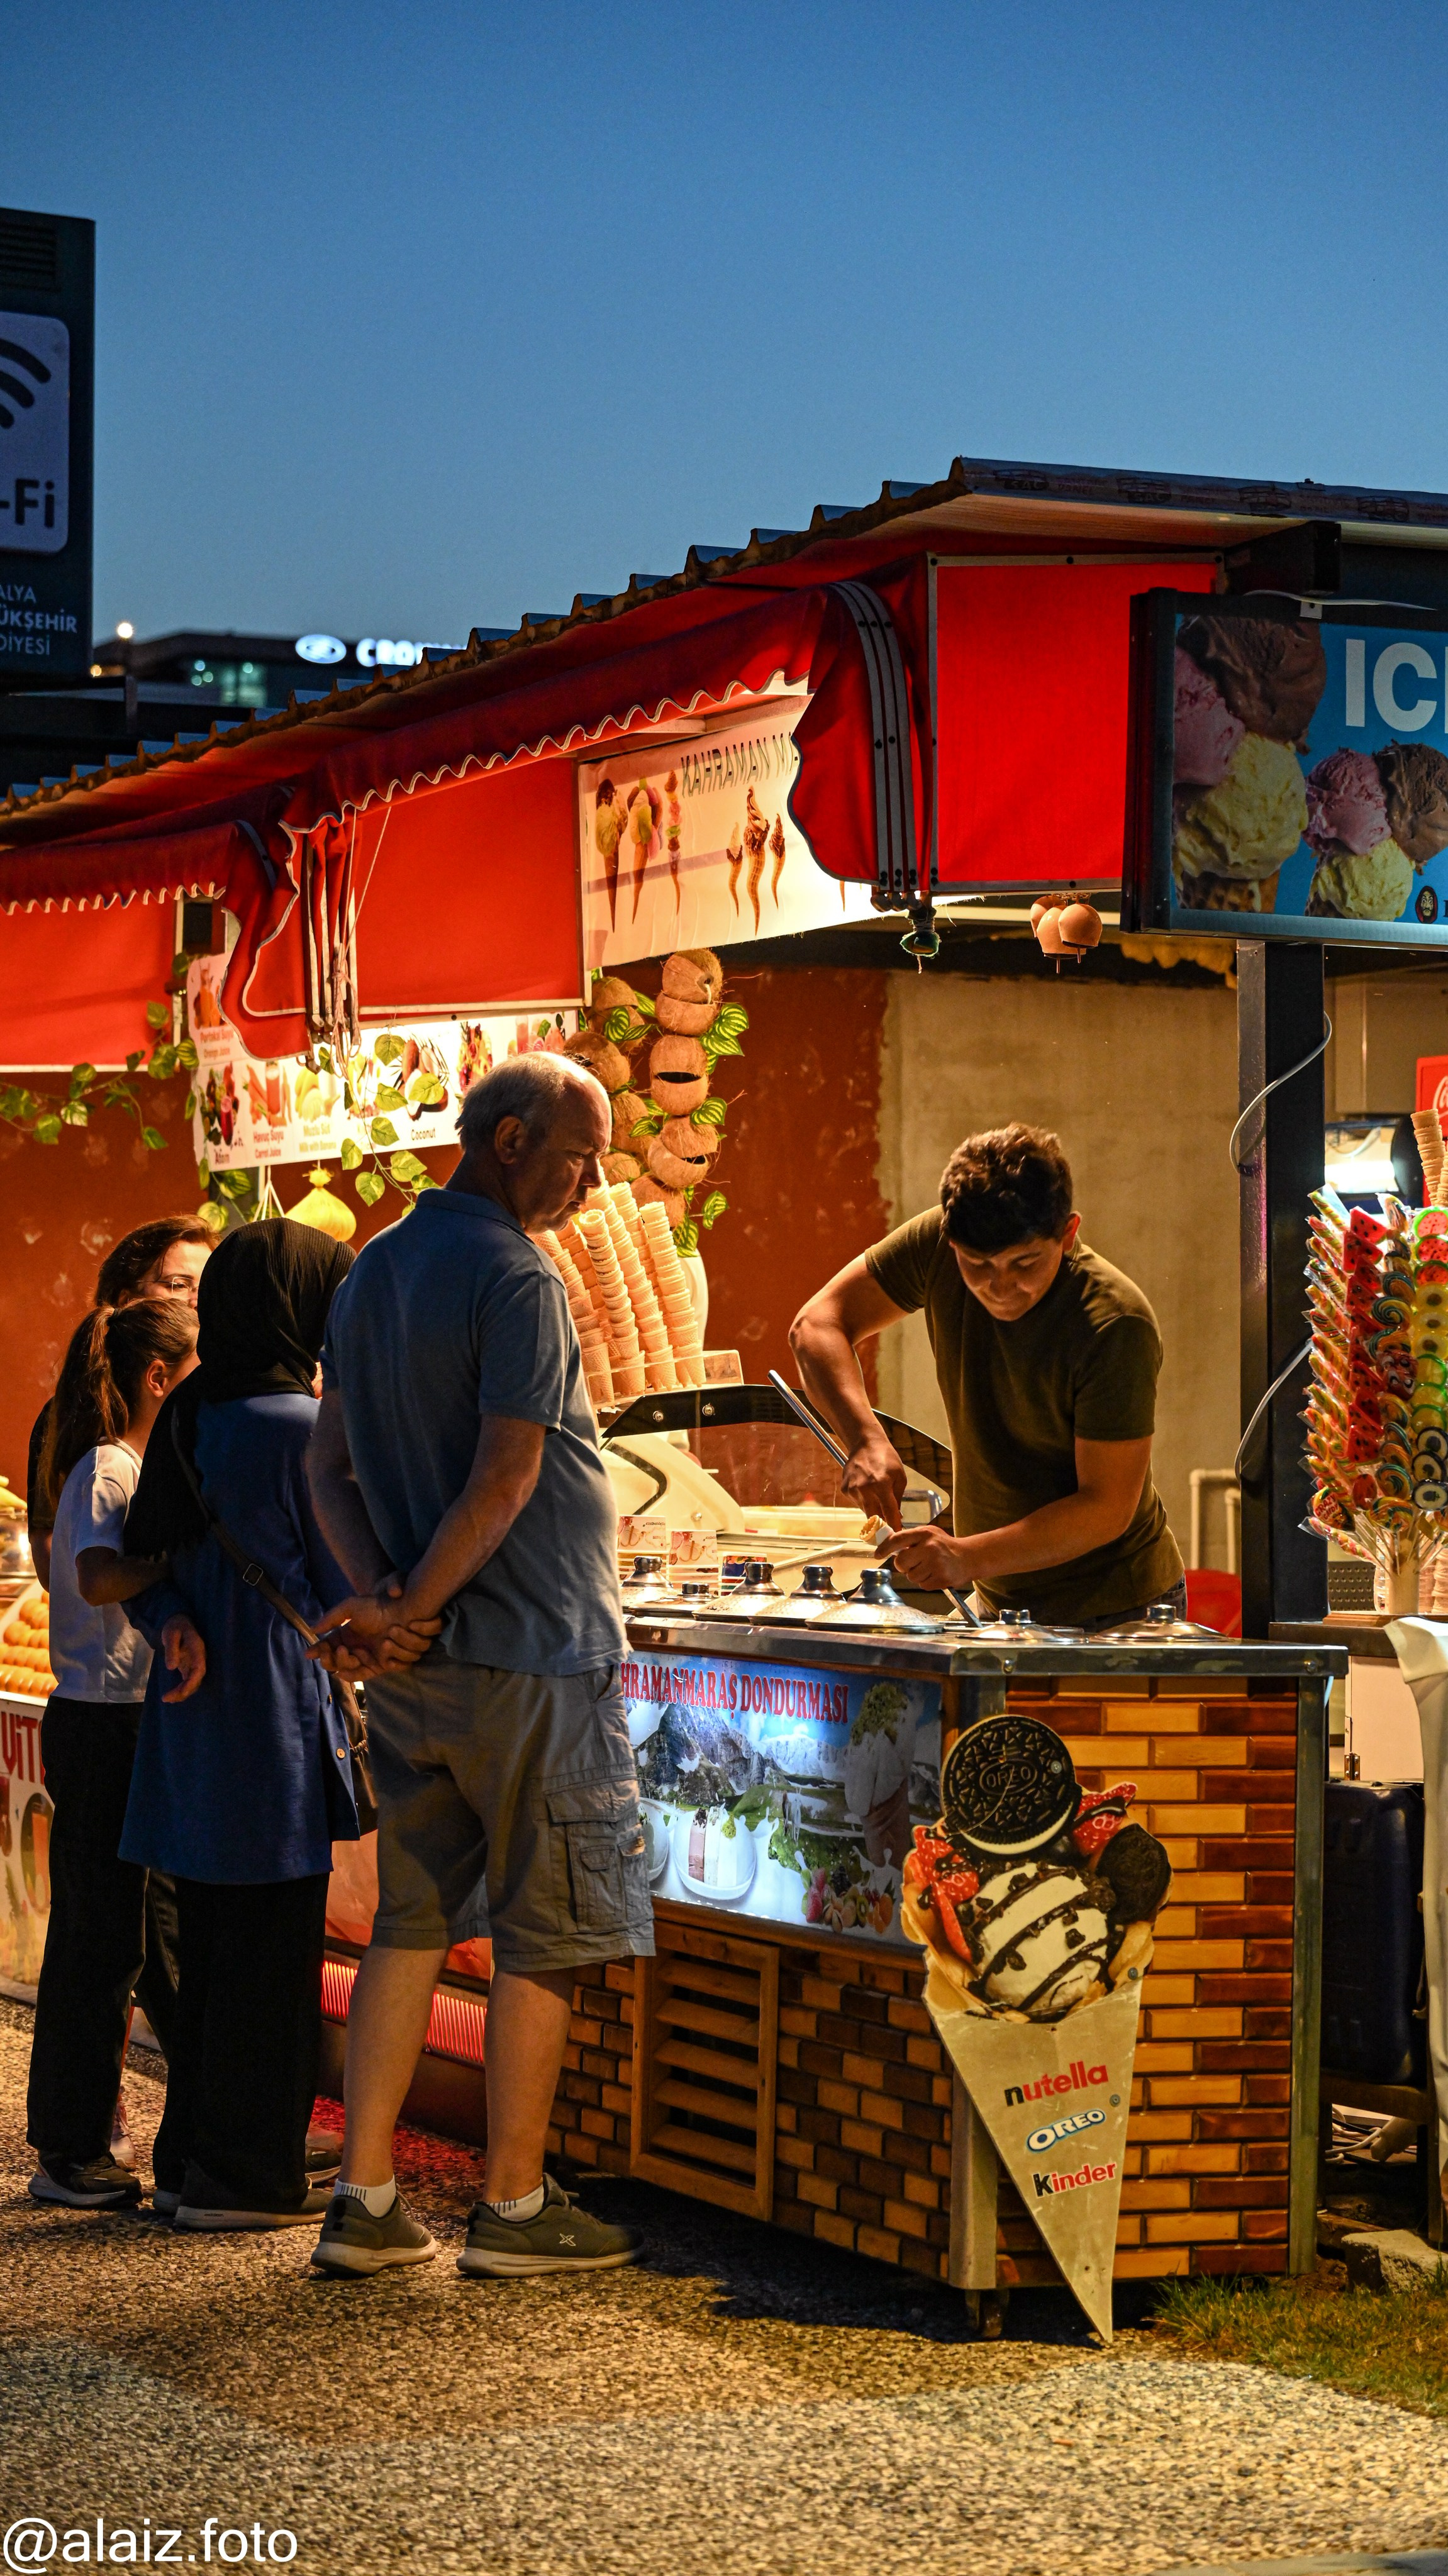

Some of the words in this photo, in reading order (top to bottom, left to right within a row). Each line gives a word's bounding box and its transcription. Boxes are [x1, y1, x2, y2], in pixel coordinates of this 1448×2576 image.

[1345, 638, 1448, 734] IC
[681, 737, 771, 798] KAHRAMAN
[411, 1128, 436, 1141] Coconut
[740, 1674, 849, 1724] DONDURMASI
[986, 1765, 1032, 1787] OREO
[1004, 2060, 1109, 2107] nutella
[1028, 2109, 1105, 2151] OREO
